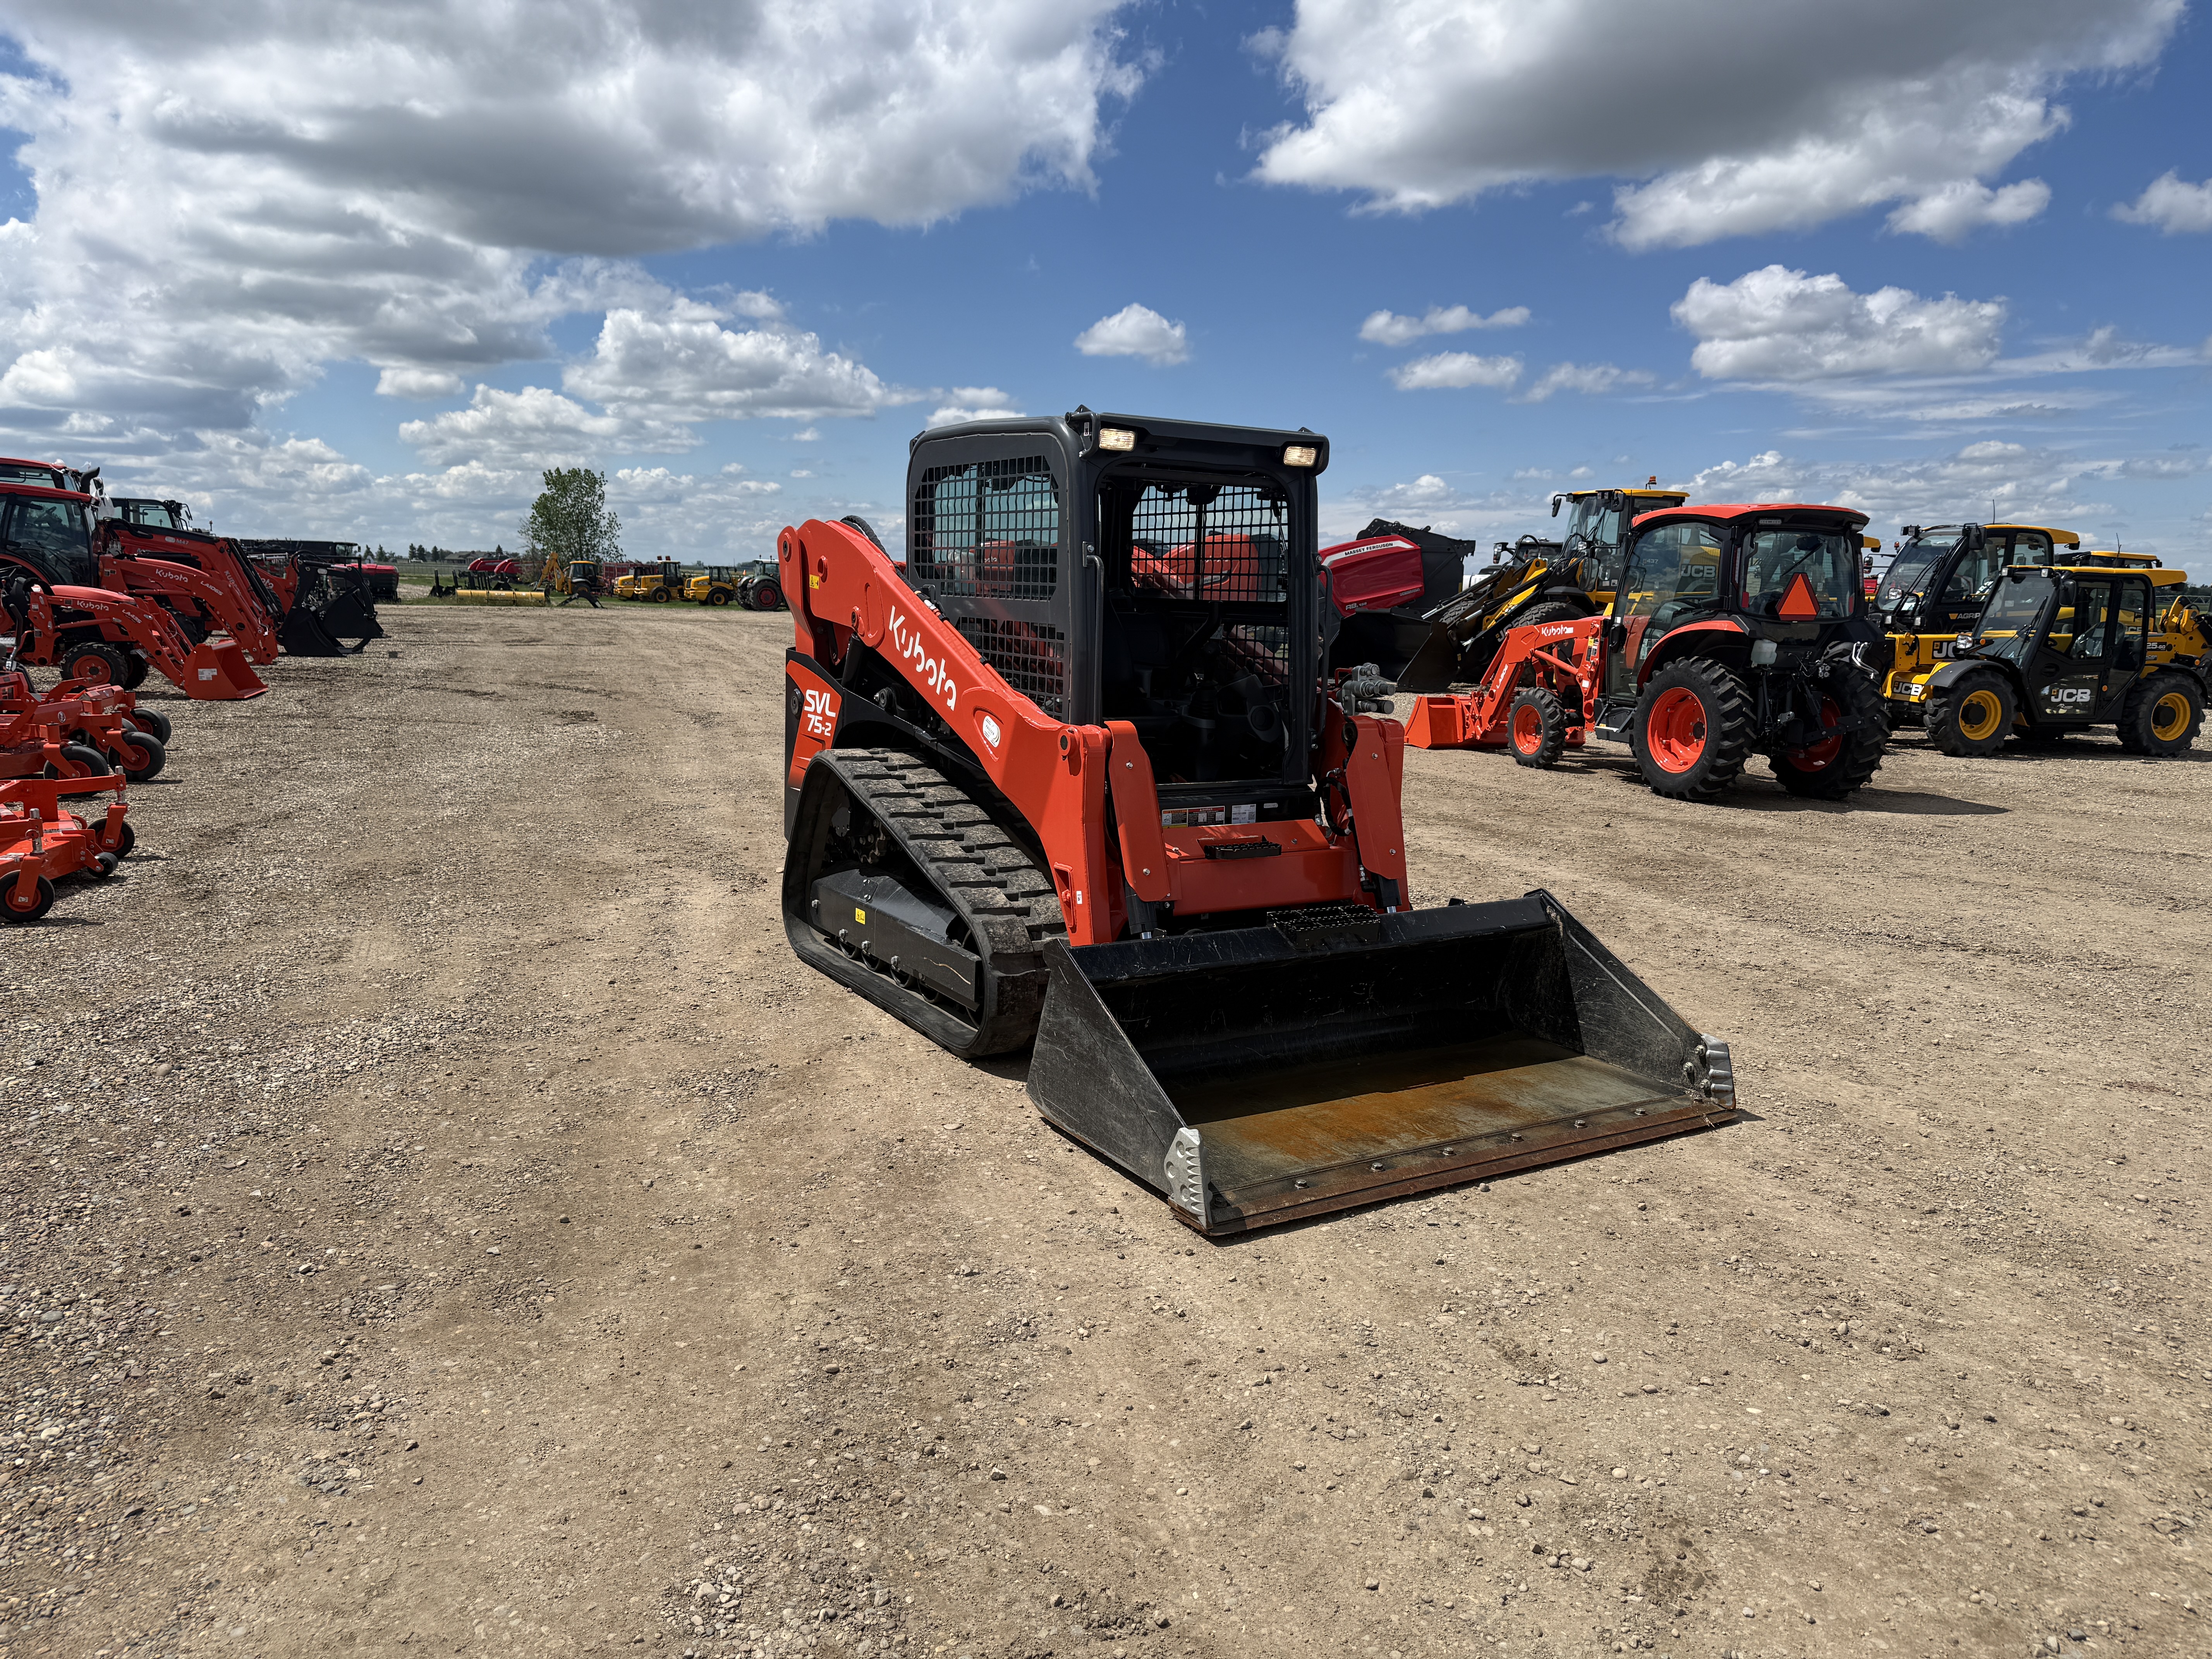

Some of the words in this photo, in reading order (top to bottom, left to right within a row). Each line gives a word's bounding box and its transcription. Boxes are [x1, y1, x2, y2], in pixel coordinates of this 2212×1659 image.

[1345, 548, 1365, 556] MASSEY
[1366, 543, 1393, 551] FERGUSON
[156, 568, 188, 582] Kubota
[1681, 565, 1716, 578] JCB
[77, 600, 109, 611] Kubota
[1541, 624, 1568, 636] Kubota
[1933, 642, 1965, 658] JC
[888, 605, 957, 711] Kubota
[1893, 682, 1923, 696] JCB
[2051, 689, 2091, 702] JCB
[804, 689, 836, 718] SVL
[807, 713, 832, 737] 75-2
